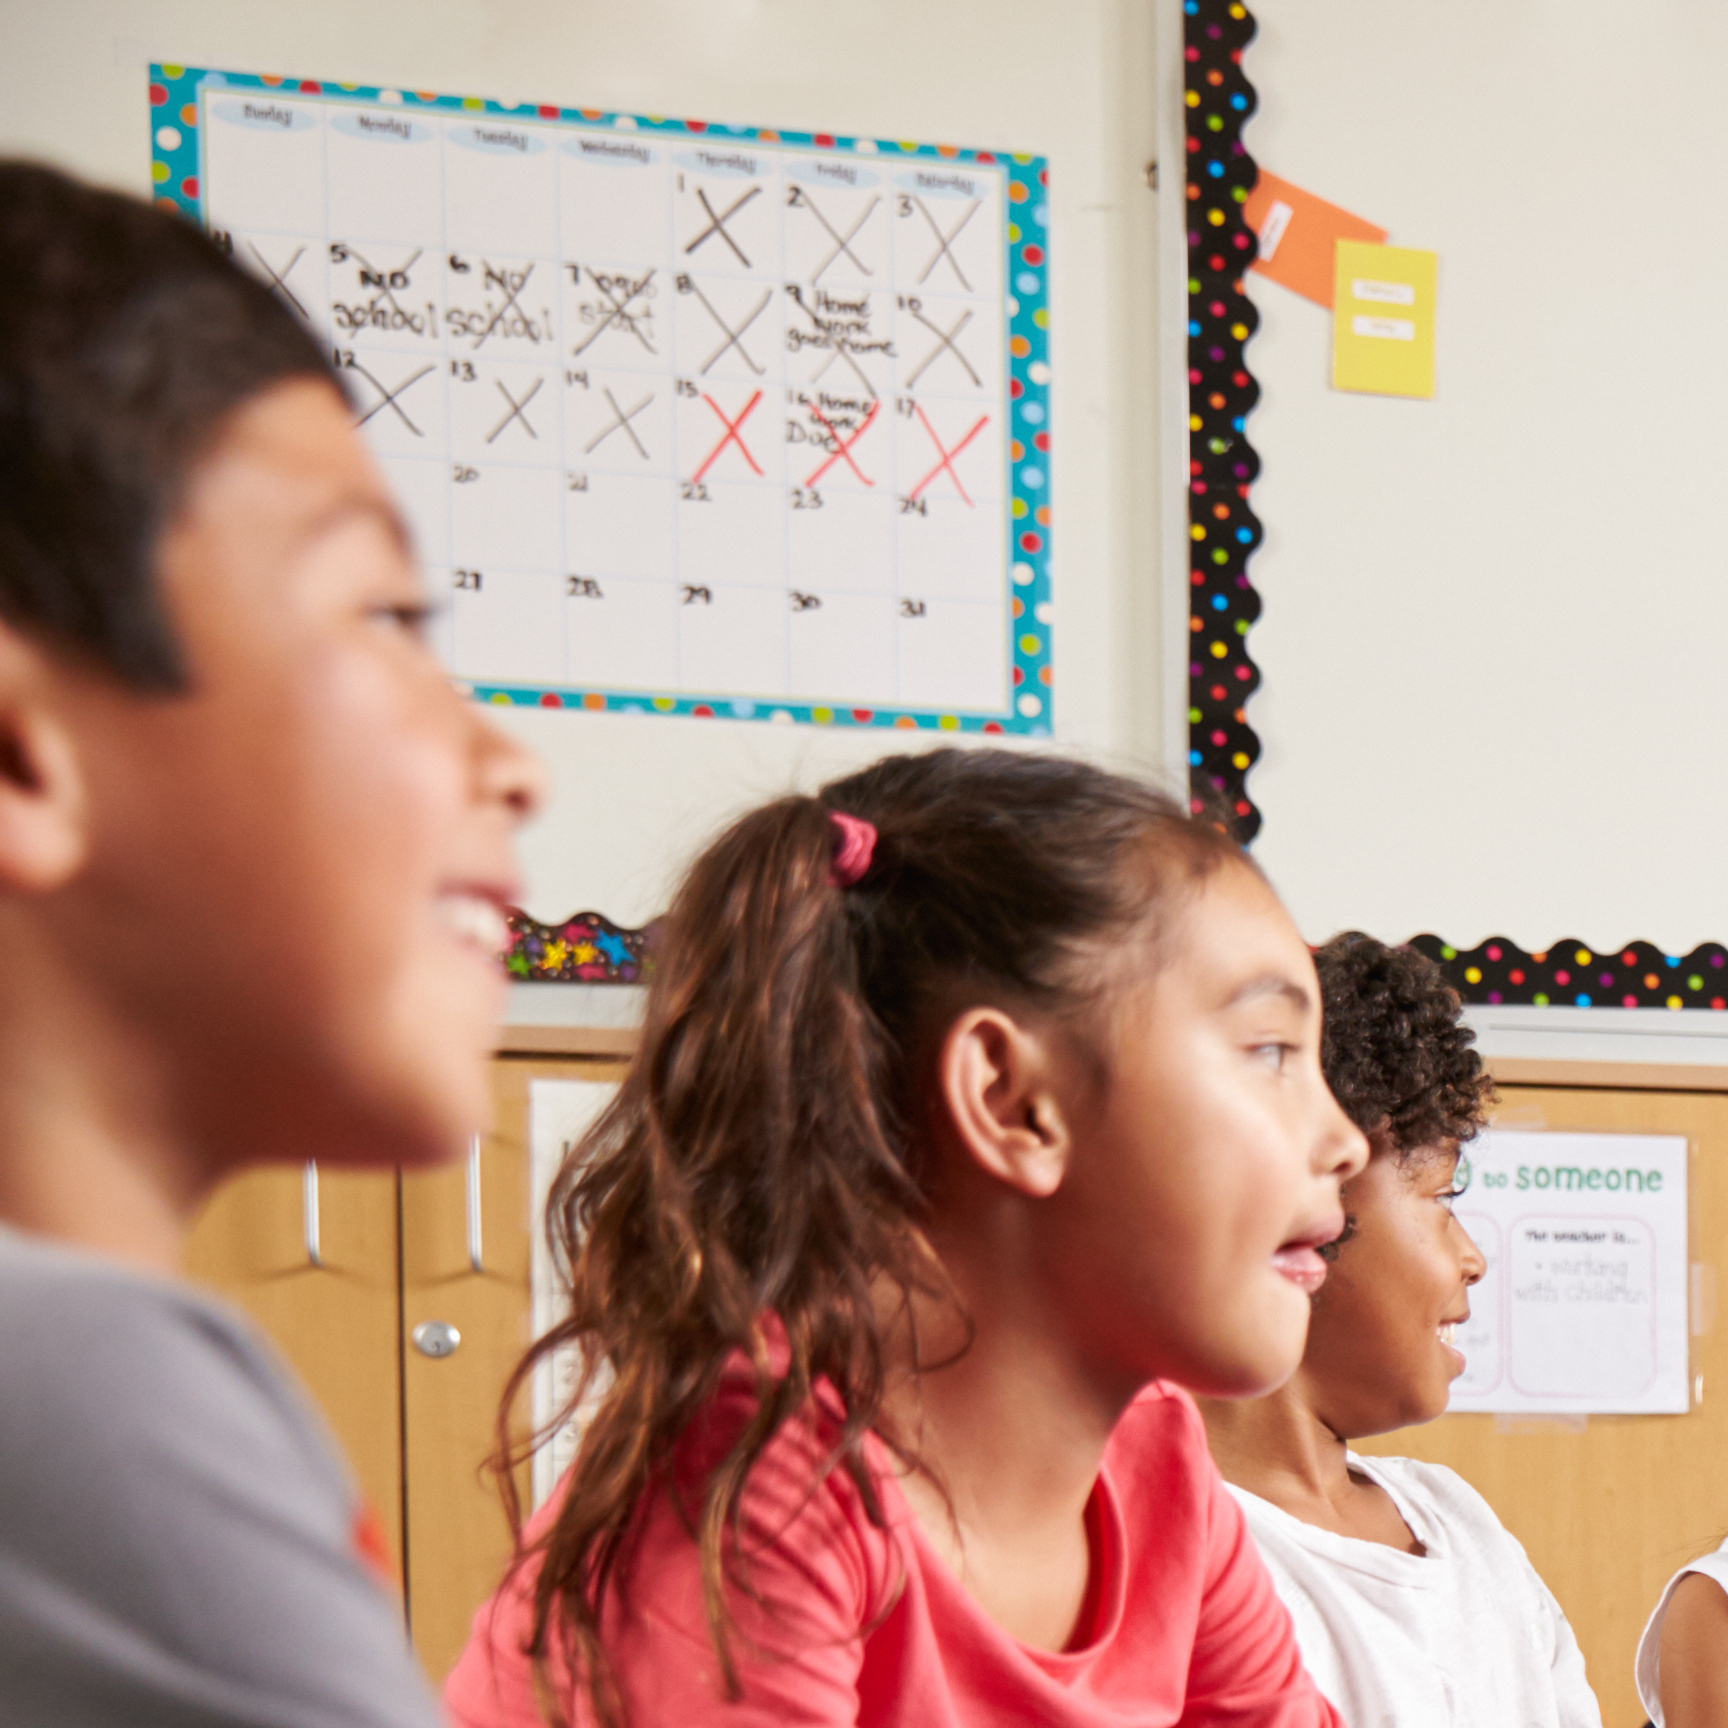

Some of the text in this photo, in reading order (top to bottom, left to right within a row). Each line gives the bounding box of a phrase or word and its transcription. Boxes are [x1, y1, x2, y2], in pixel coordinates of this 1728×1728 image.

[786, 186, 804, 207] 2
[897, 193, 914, 218] 3
[329, 243, 347, 264] 5
[448, 254, 470, 274] 6
[563, 263, 580, 285] 7
[675, 272, 692, 293] 8
[332, 298, 440, 340] school
[446, 300, 552, 342] school
[333, 348, 355, 369] 12
[450, 360, 478, 382] 13
[565, 369, 590, 391] 14
[675, 378, 698, 398] 15
[896, 396, 916, 419] 17
[453, 464, 480, 483] 20
[680, 482, 711, 502] 22
[790, 490, 824, 511] 23
[453, 569, 483, 593] 27
[681, 585, 712, 607] 29
[788, 592, 822, 613] 30
[899, 600, 926, 620] 31
[1482, 1171, 1509, 1188] to
[1515, 1165, 1664, 1192] someone
